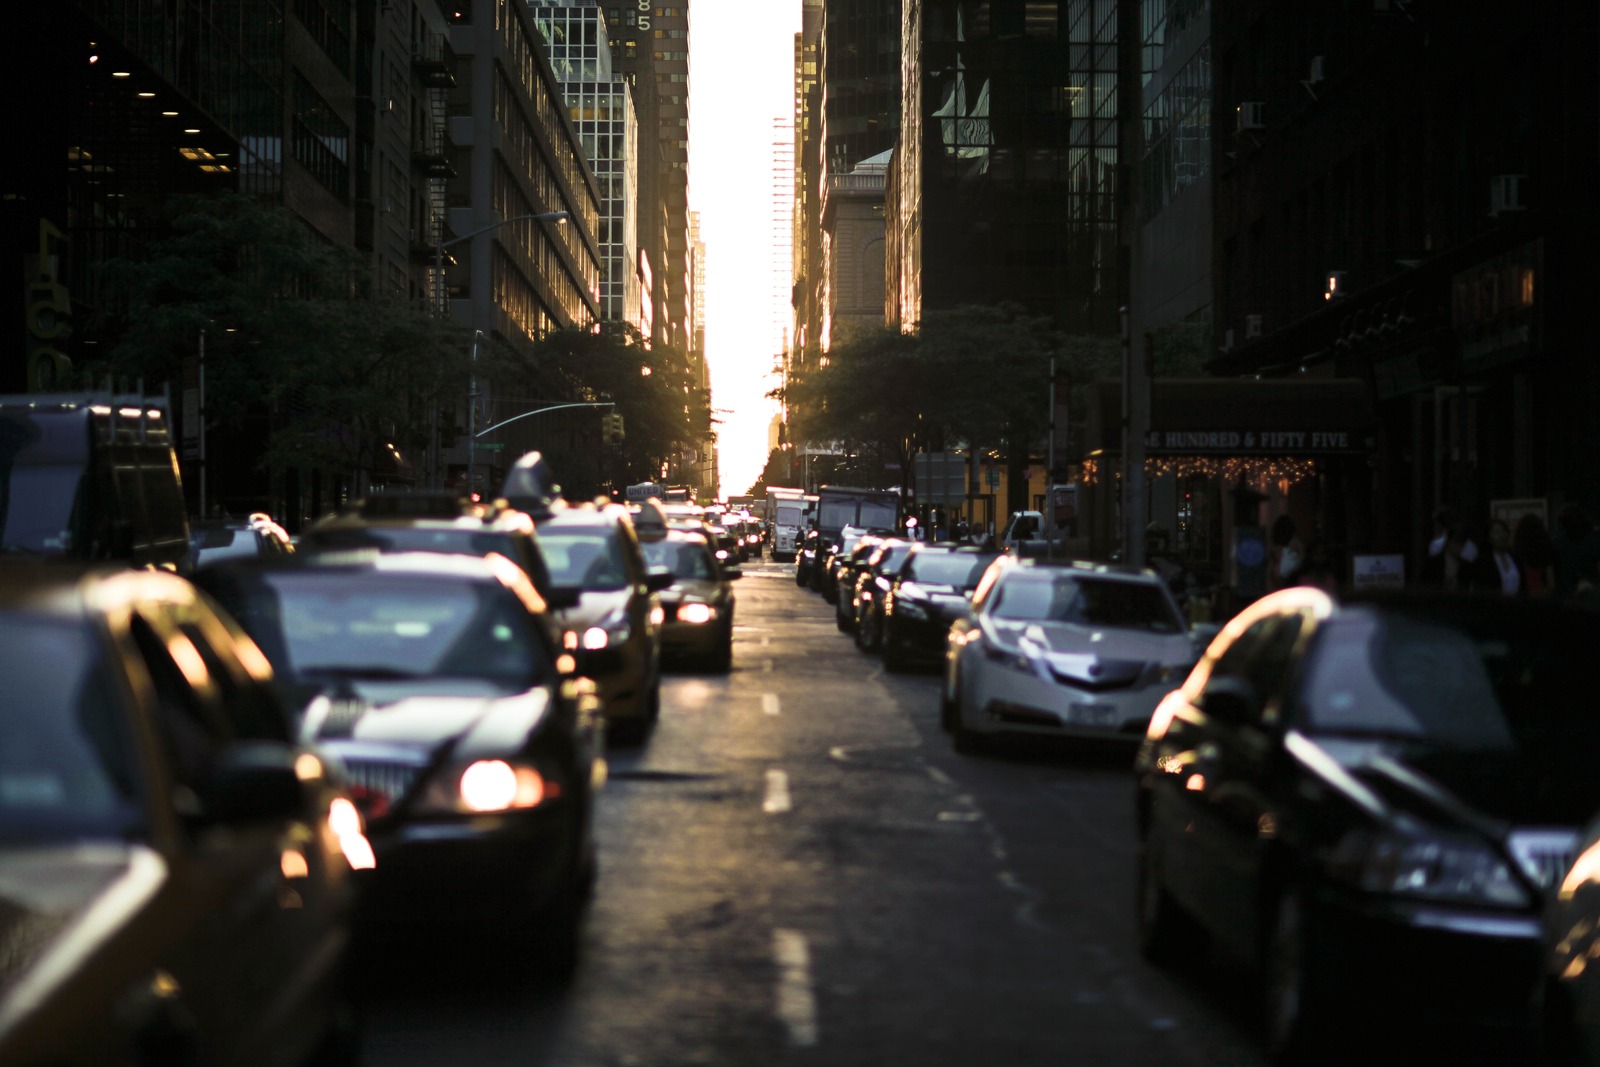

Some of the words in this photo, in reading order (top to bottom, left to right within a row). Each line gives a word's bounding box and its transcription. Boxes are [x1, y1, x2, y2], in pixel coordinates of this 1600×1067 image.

[1165, 431, 1241, 447] HUNDRED
[1243, 431, 1256, 447] &
[1260, 431, 1306, 447] FIFTY
[1311, 431, 1349, 447] FIVE
[628, 486, 659, 495] UNITED
